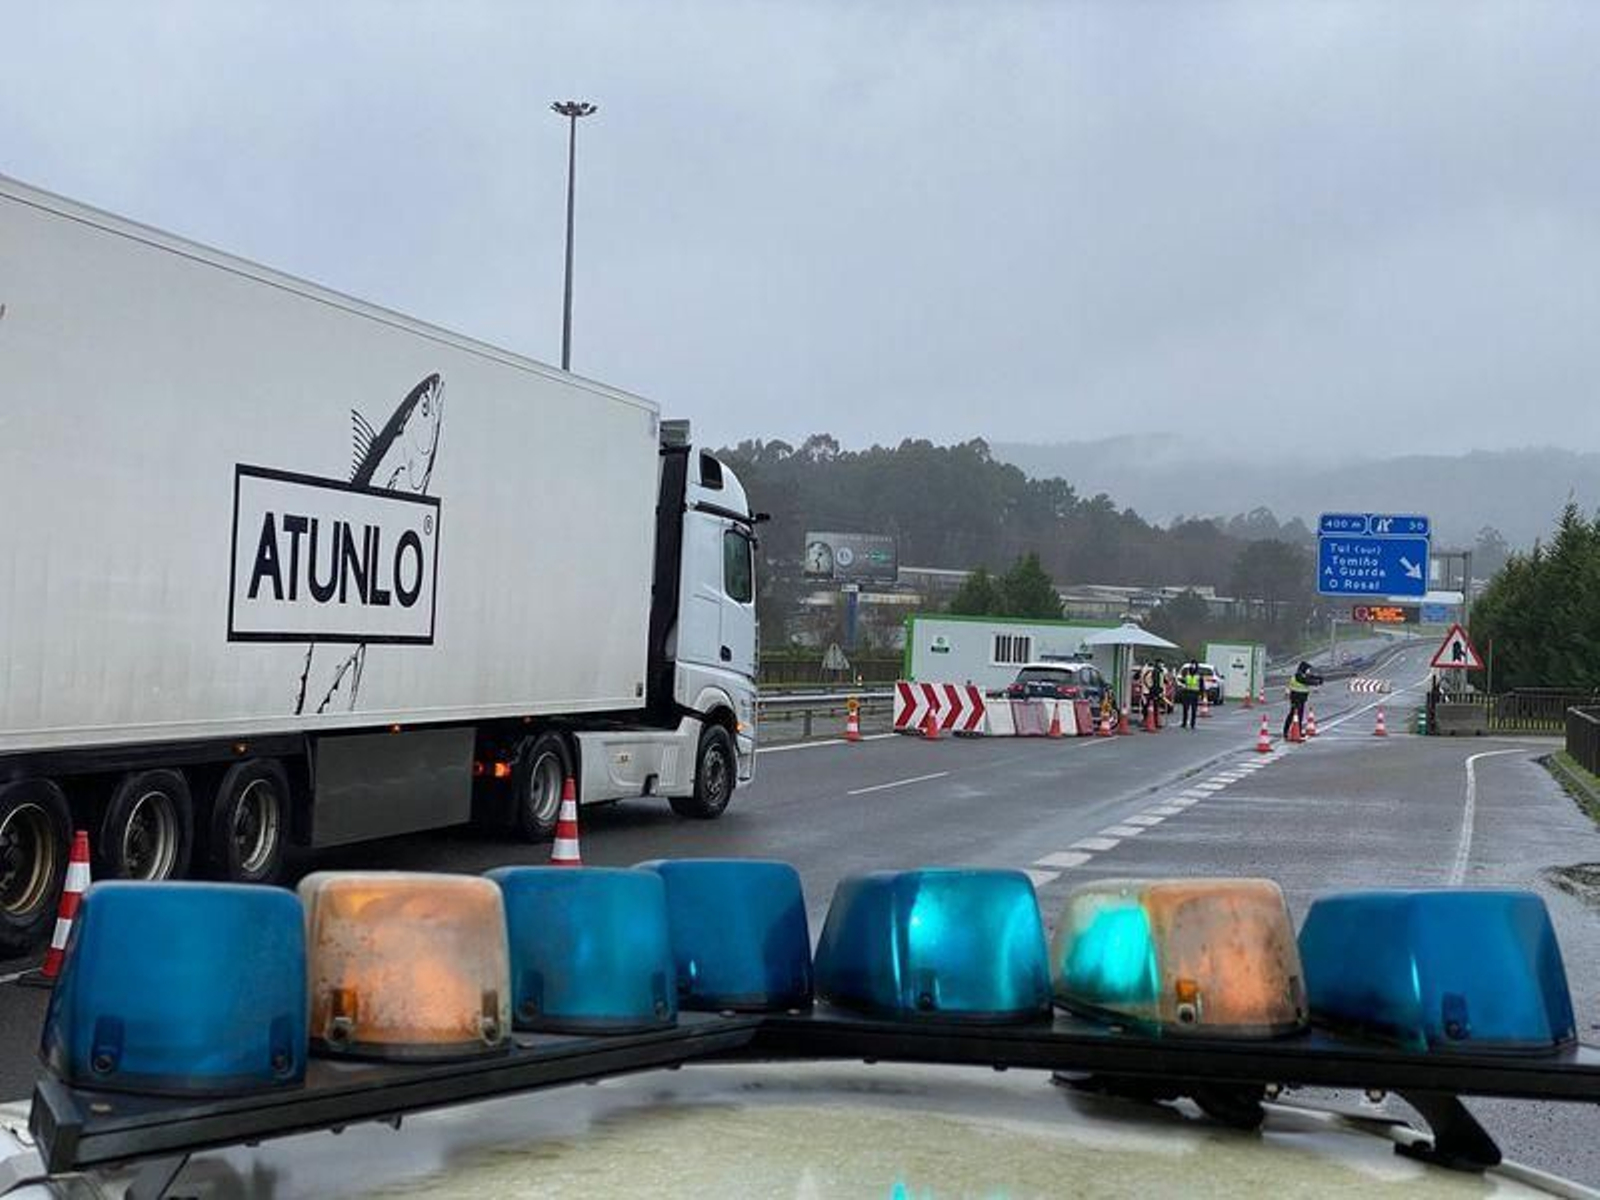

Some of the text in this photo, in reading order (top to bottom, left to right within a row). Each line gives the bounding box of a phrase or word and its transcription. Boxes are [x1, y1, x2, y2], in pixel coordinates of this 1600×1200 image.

[1324, 518, 1348, 528] 400
[1330, 543, 1351, 553] Tui
[247, 511, 424, 608] ATUNLO
[1325, 566, 1387, 577] A Guarda
[1329, 578, 1381, 590] O Rosal
